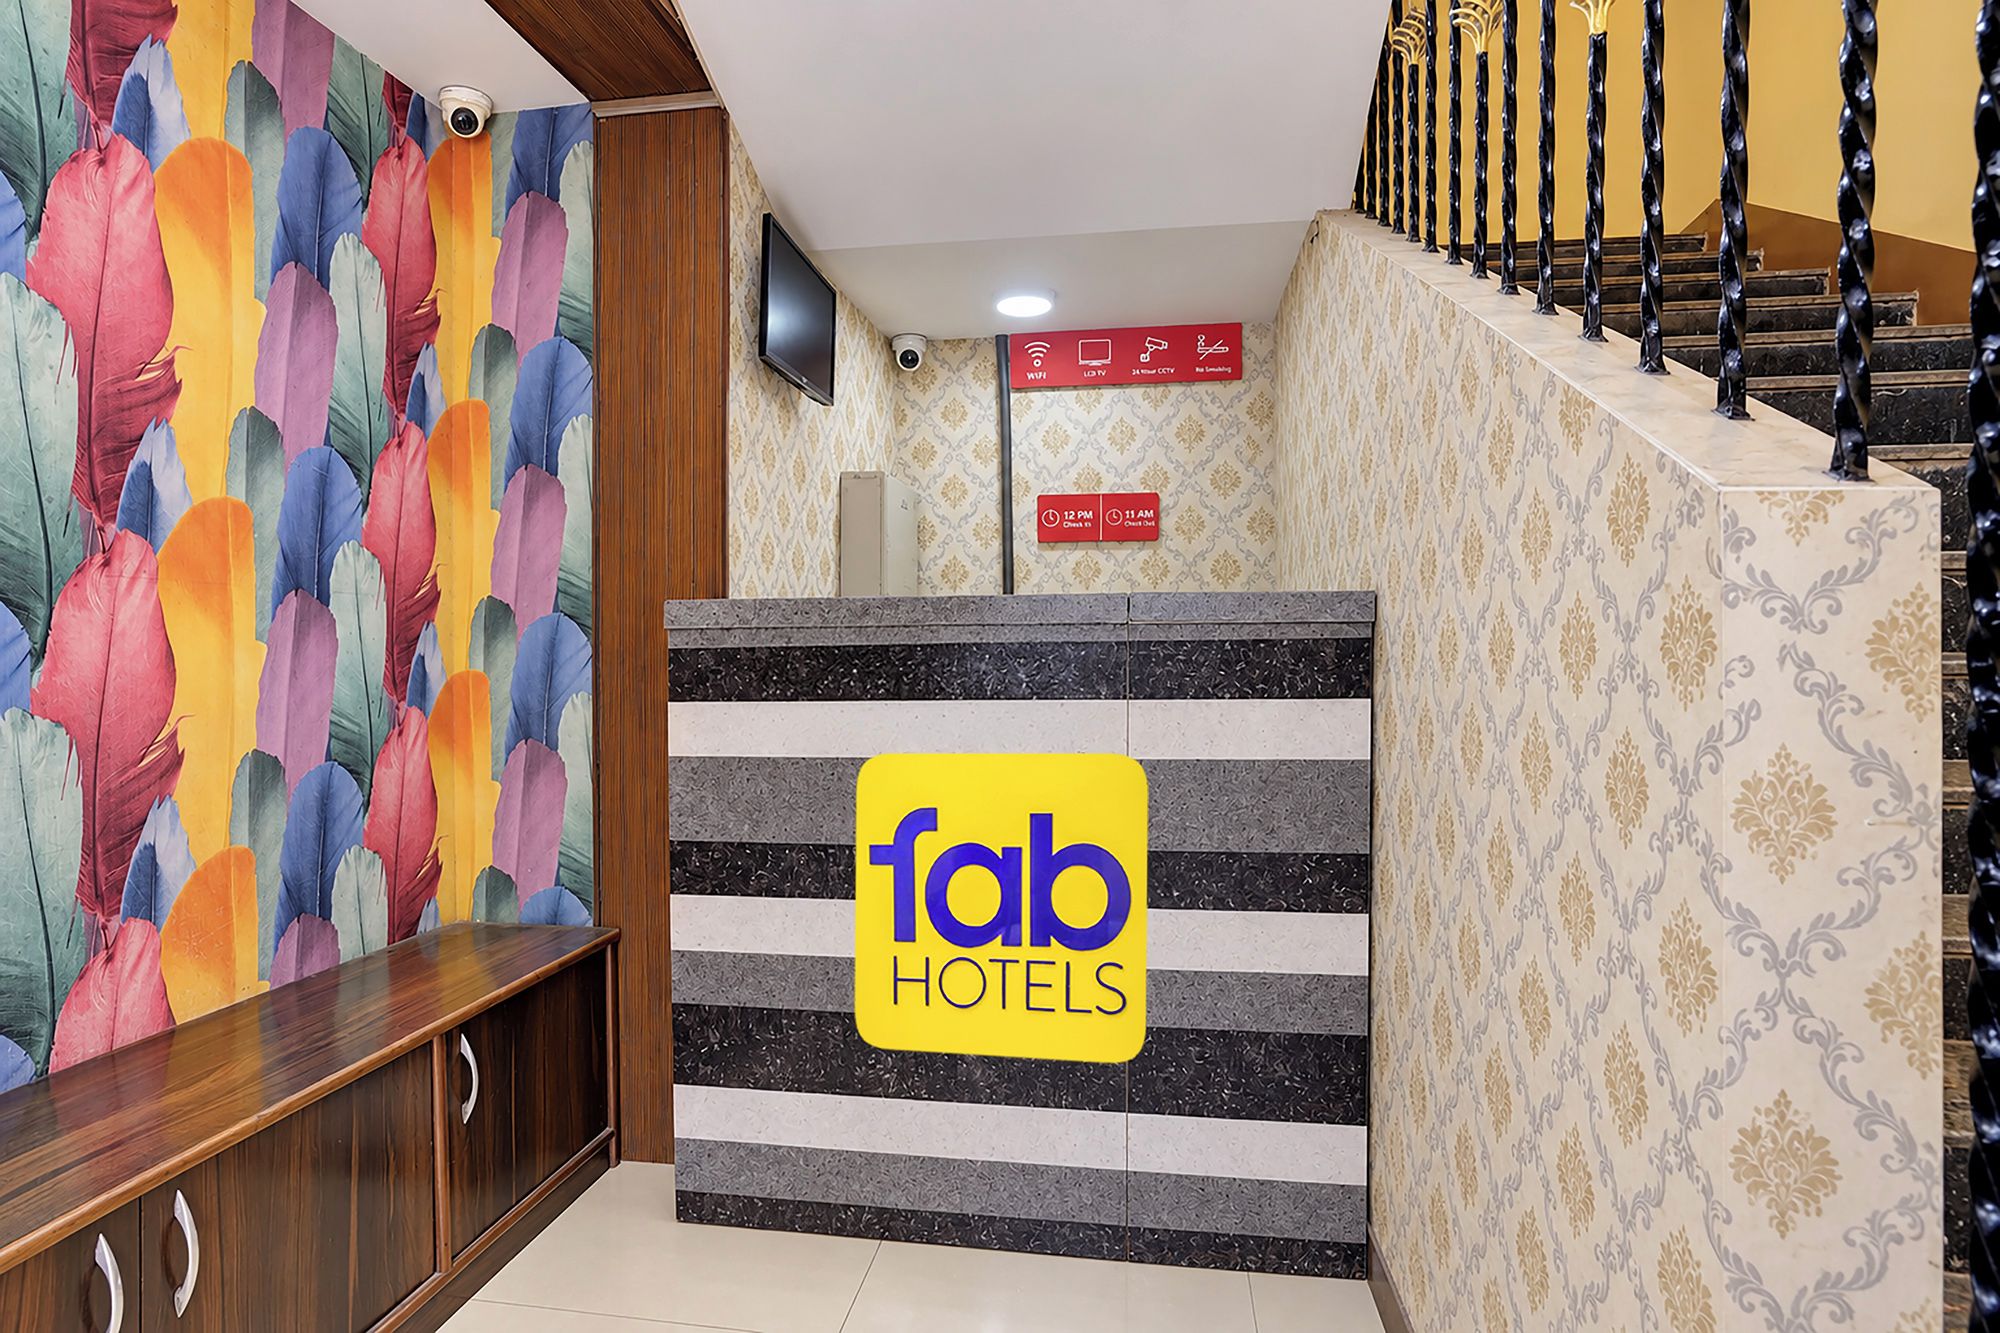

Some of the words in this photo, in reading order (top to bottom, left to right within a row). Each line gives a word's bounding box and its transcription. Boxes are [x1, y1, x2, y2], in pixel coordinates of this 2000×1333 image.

[1158, 367, 1175, 375] CCTV
[1063, 510, 1075, 520] 12
[1077, 510, 1093, 520] PM
[1125, 510, 1135, 519] 11
[1137, 509, 1154, 519] AM
[869, 807, 1131, 951] fab
[893, 956, 1127, 1015] HOTELS
